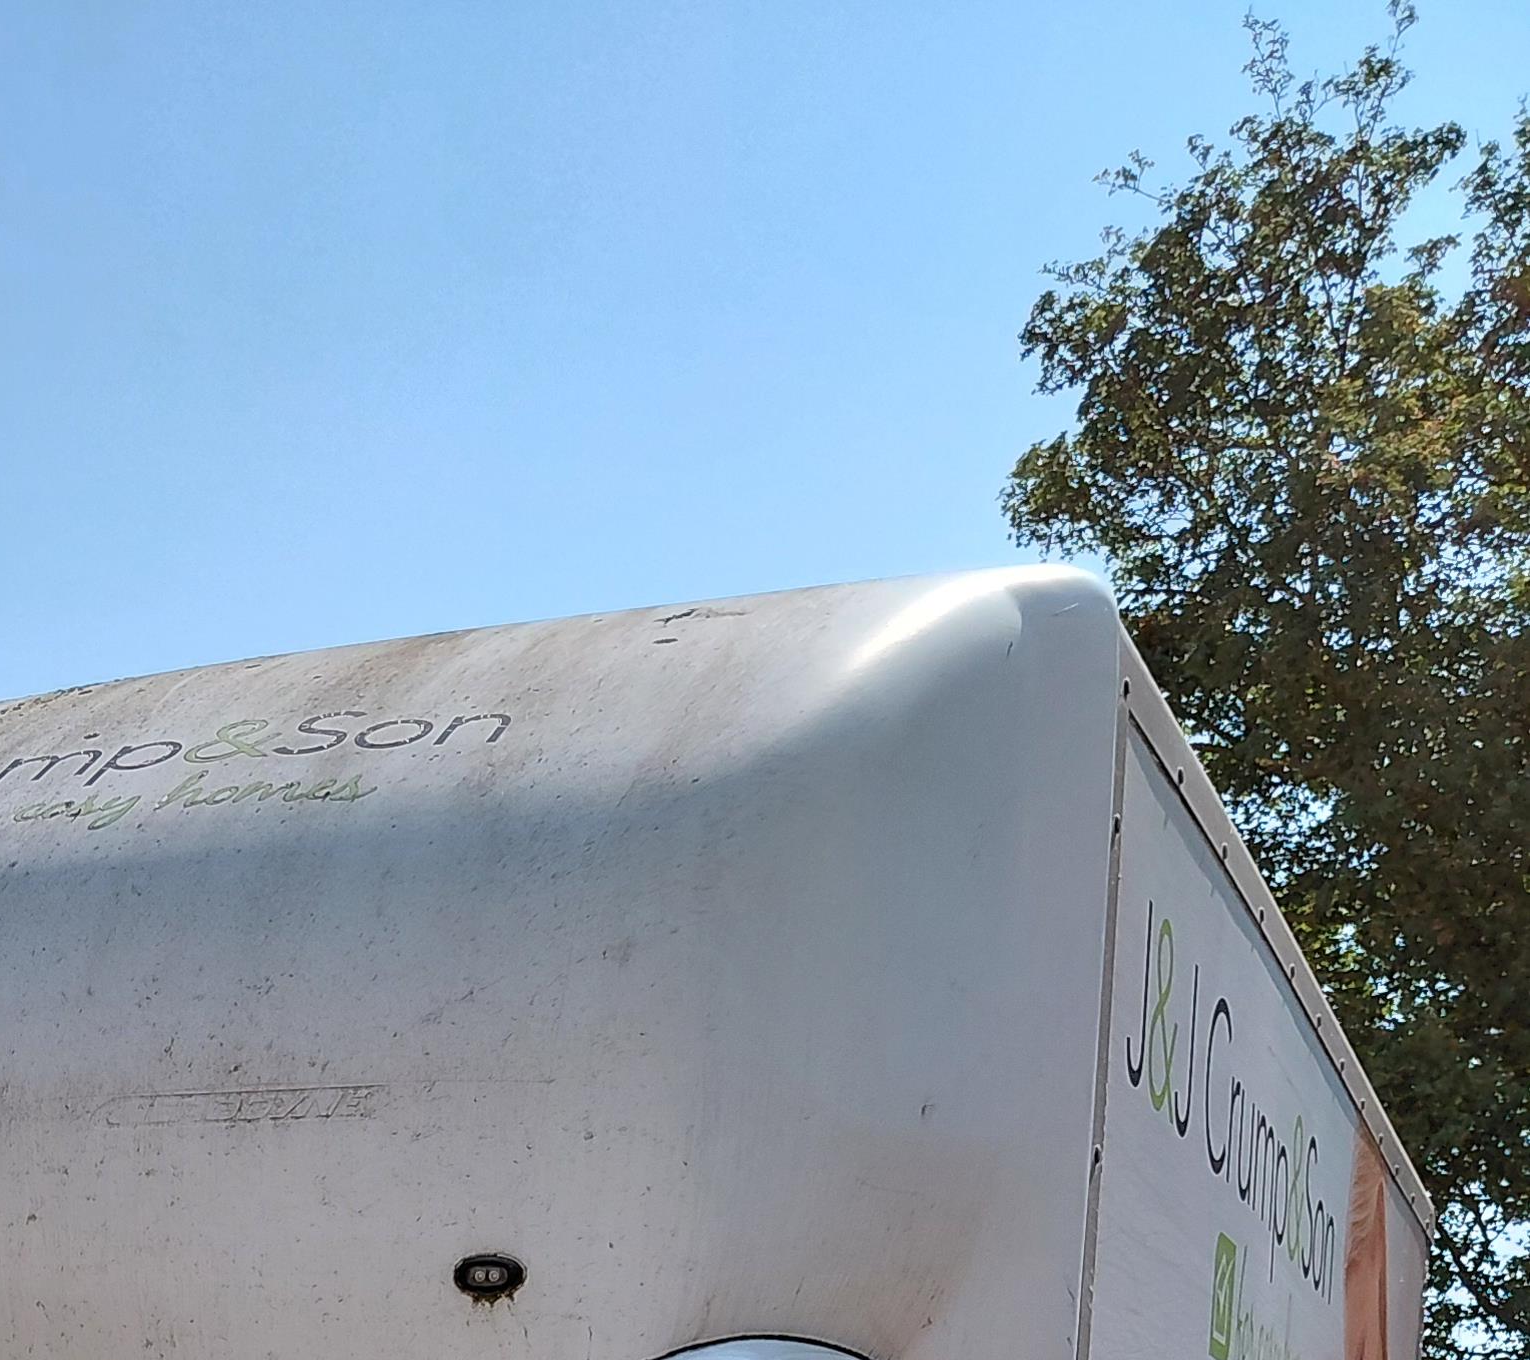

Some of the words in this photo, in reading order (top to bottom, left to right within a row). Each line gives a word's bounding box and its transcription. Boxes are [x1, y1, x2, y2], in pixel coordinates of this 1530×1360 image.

[154, 769, 379, 813] homes
[1125, 899, 1198, 1139] J&J
[1206, 998, 1337, 1304] Crump&Son
